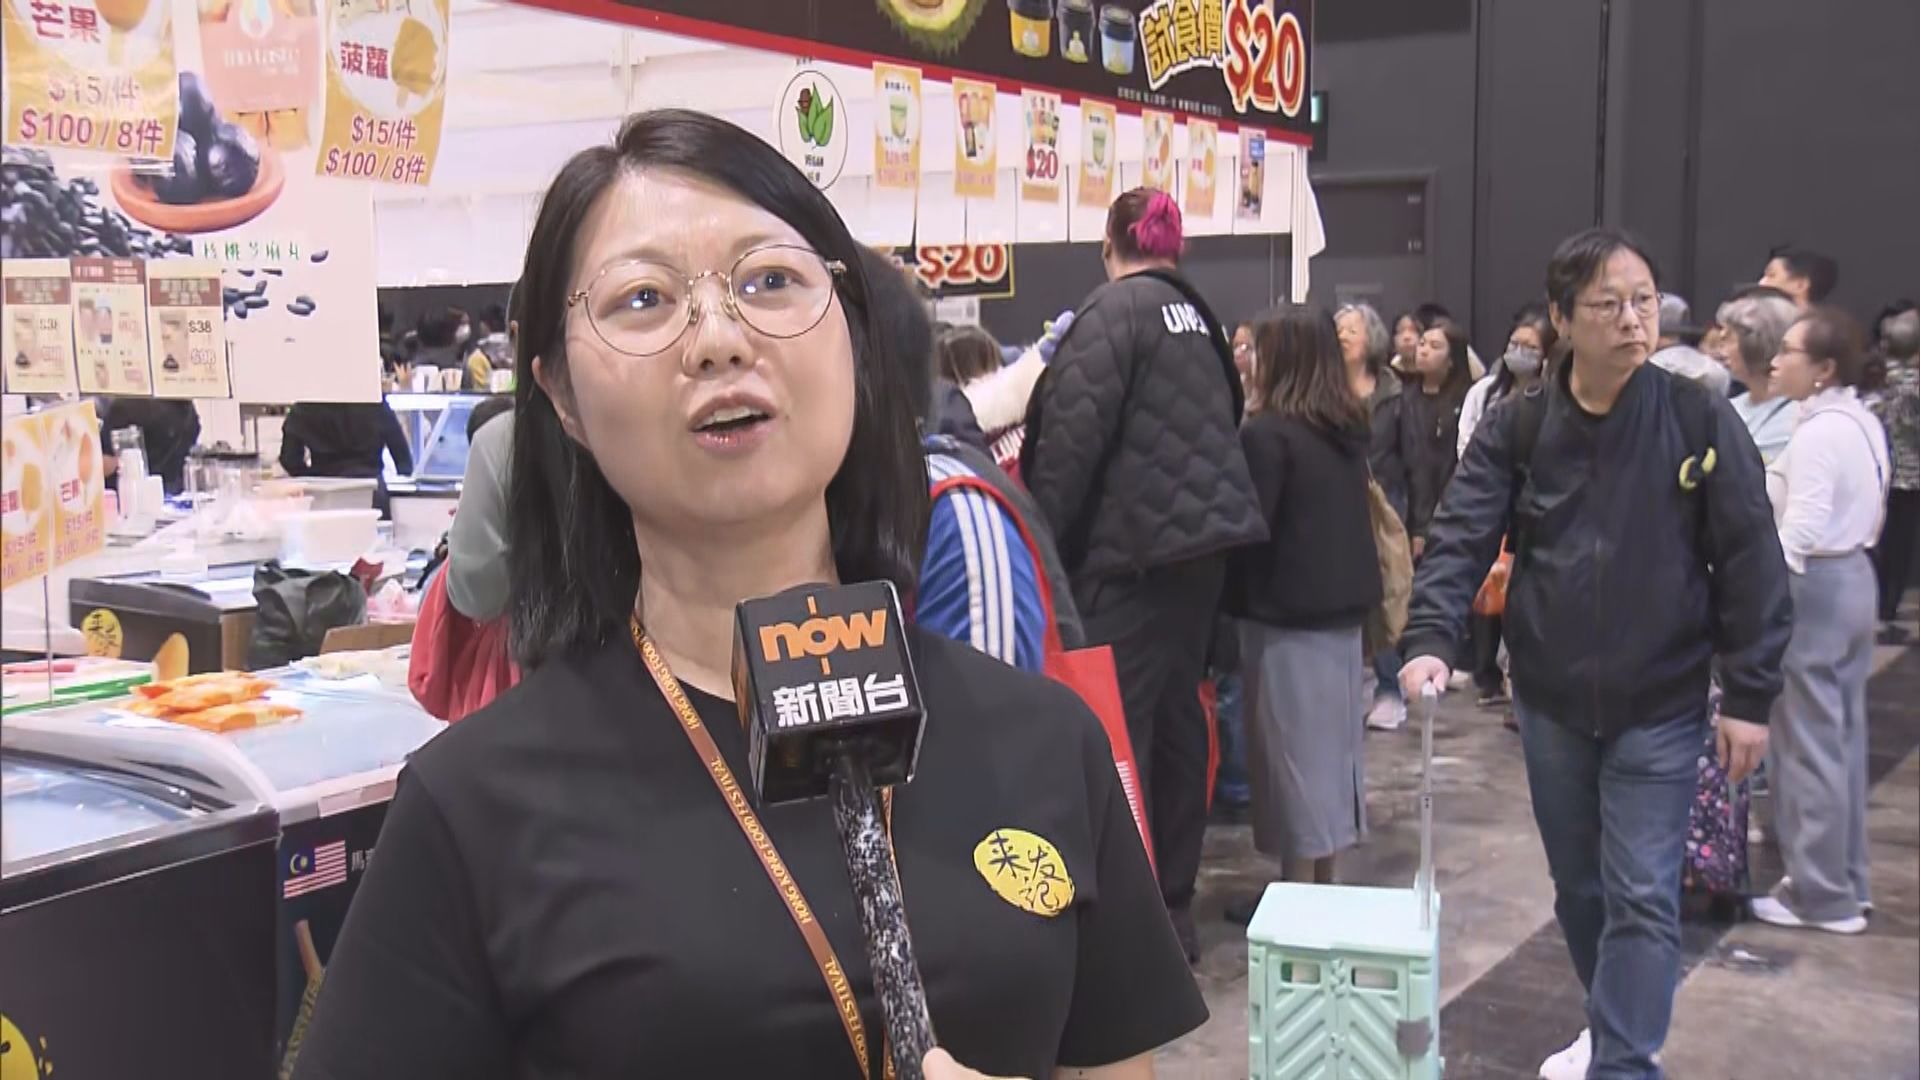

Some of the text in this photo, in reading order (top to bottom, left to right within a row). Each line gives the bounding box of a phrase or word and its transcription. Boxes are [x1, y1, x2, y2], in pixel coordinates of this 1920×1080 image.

[31, 1, 99, 42] 芒果
[340, 41, 389, 80] 菠蘿
[1141, 0, 1304, 110] 試食價 $20
[20, 108, 93, 144] $100
[351, 115, 417, 151] $15/件
[325, 151, 377, 177] $100
[804, 154, 824, 168] VEGAN
[1026, 148, 1059, 180] $20
[918, 245, 1005, 286] $20
[187, 320, 212, 334] $38
[759, 609, 888, 662] now
[772, 673, 910, 727] 新聞台
[711, 756, 749, 816] FESTIVAL
[744, 816, 770, 850] FOOD
[763, 849, 791, 888] KONG
[784, 884, 812, 924] HONG
[824, 956, 862, 1032] FESTIVAL
